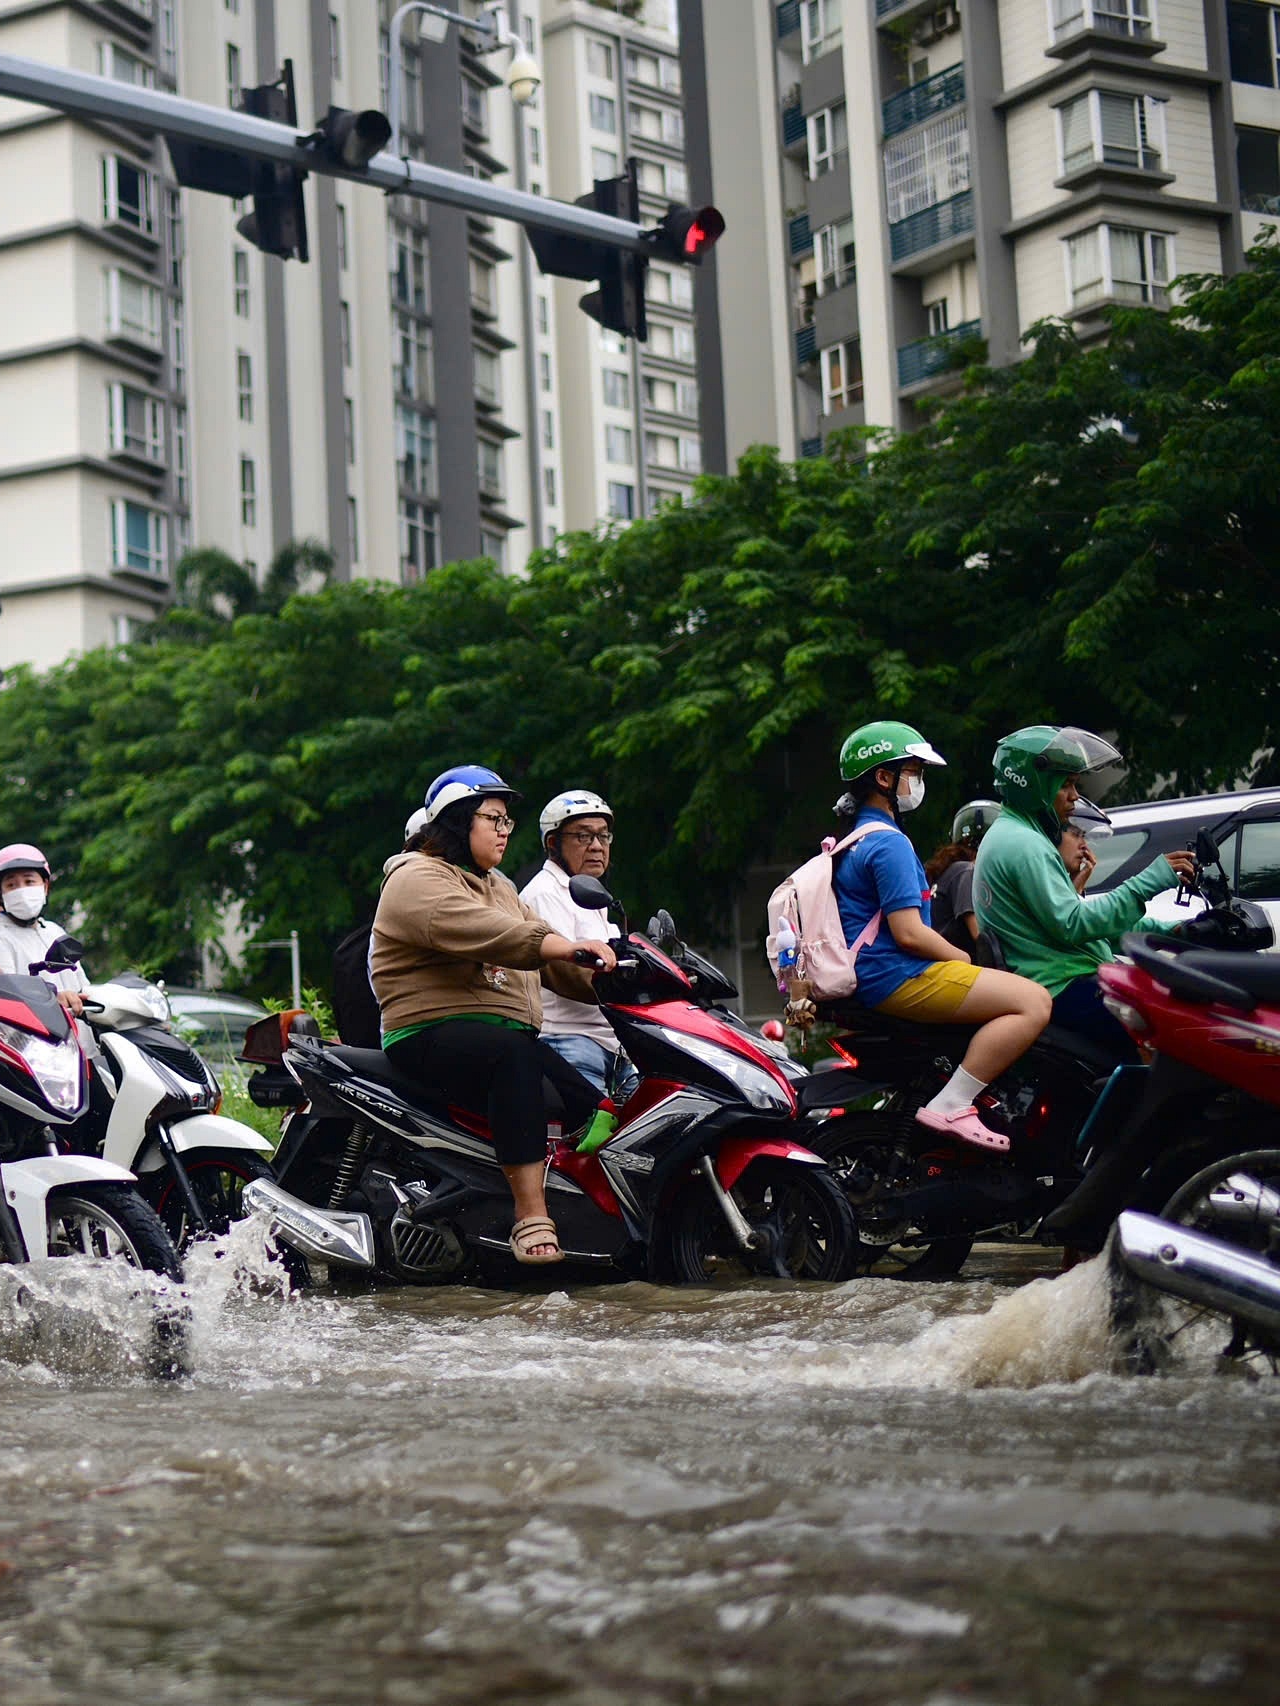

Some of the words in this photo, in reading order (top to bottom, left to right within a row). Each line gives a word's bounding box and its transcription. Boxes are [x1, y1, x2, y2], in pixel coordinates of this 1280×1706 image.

[857, 739, 893, 760] Grab
[1003, 766, 1028, 788] Grab
[329, 1082, 355, 1097] AIR
[355, 1091, 403, 1118] BLADE
